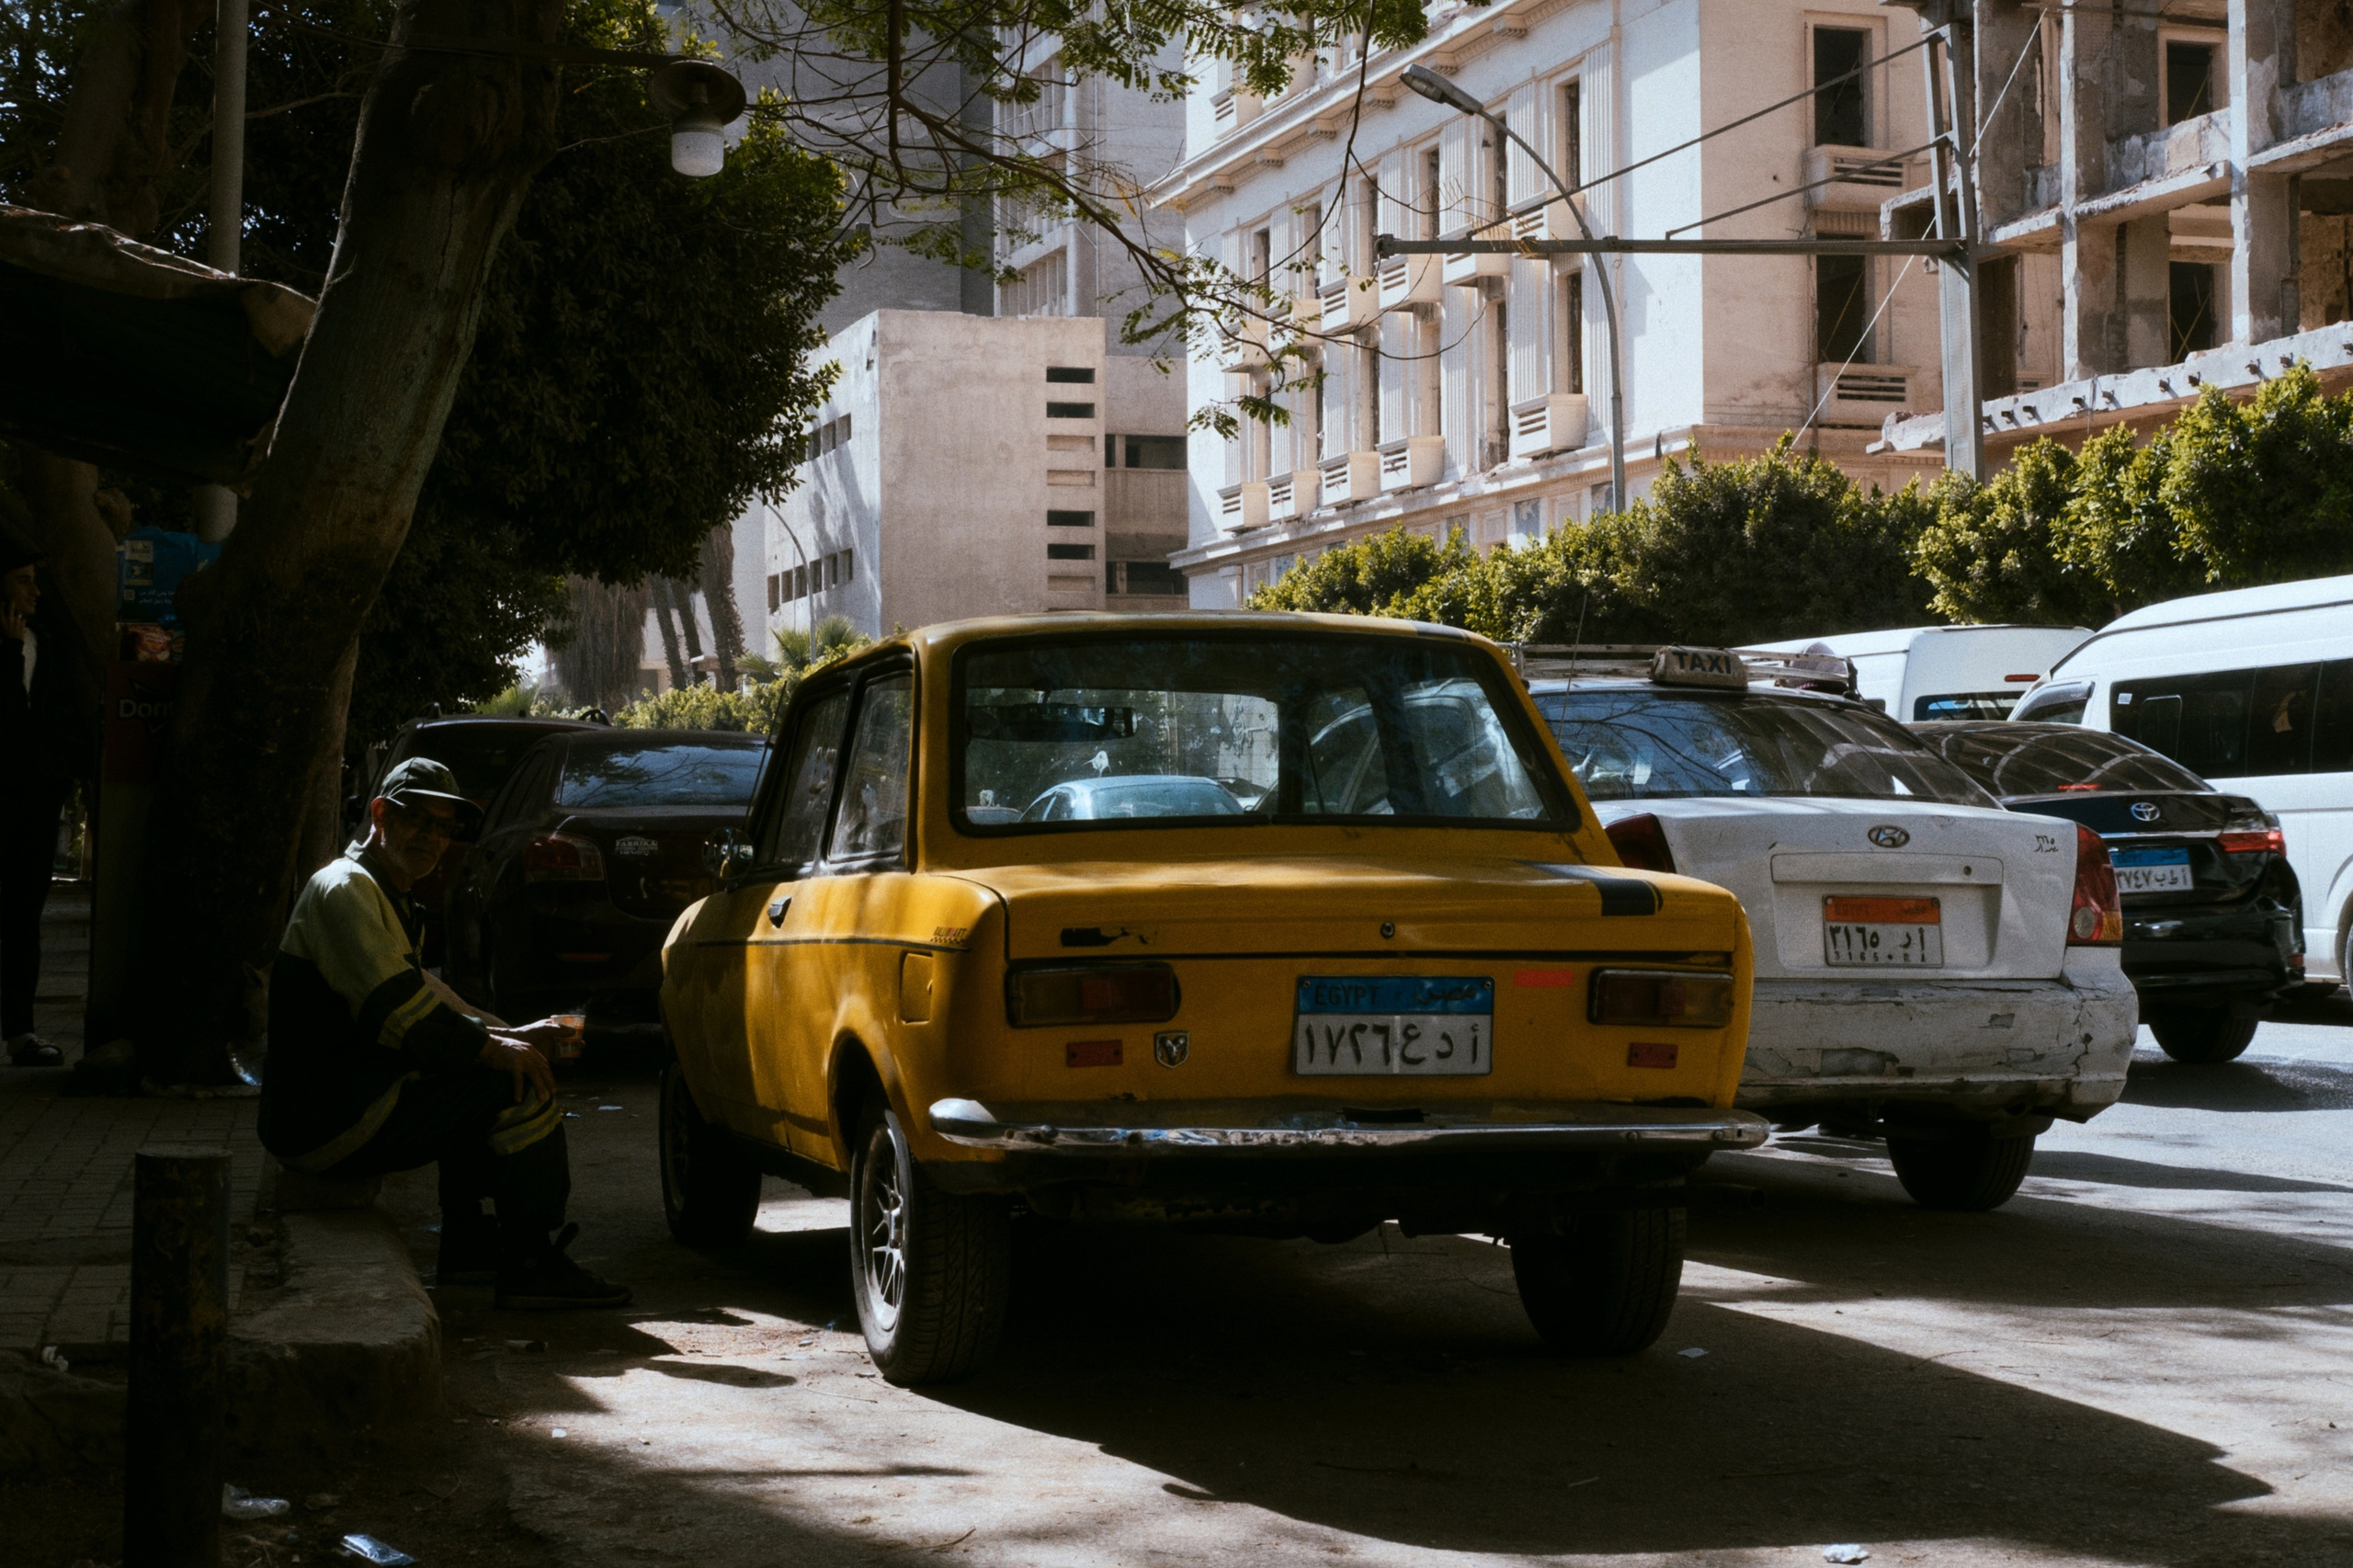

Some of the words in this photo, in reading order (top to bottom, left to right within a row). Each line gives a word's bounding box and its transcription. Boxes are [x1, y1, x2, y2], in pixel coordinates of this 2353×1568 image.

[1672, 651, 1732, 675] TAXI
[1829, 926, 1879, 951] ٣١٦٥
[1314, 984, 1380, 1006] EGYPT
[1415, 986, 1477, 1006] مصر
[1306, 1023, 1392, 1066] ١٧٢٦
